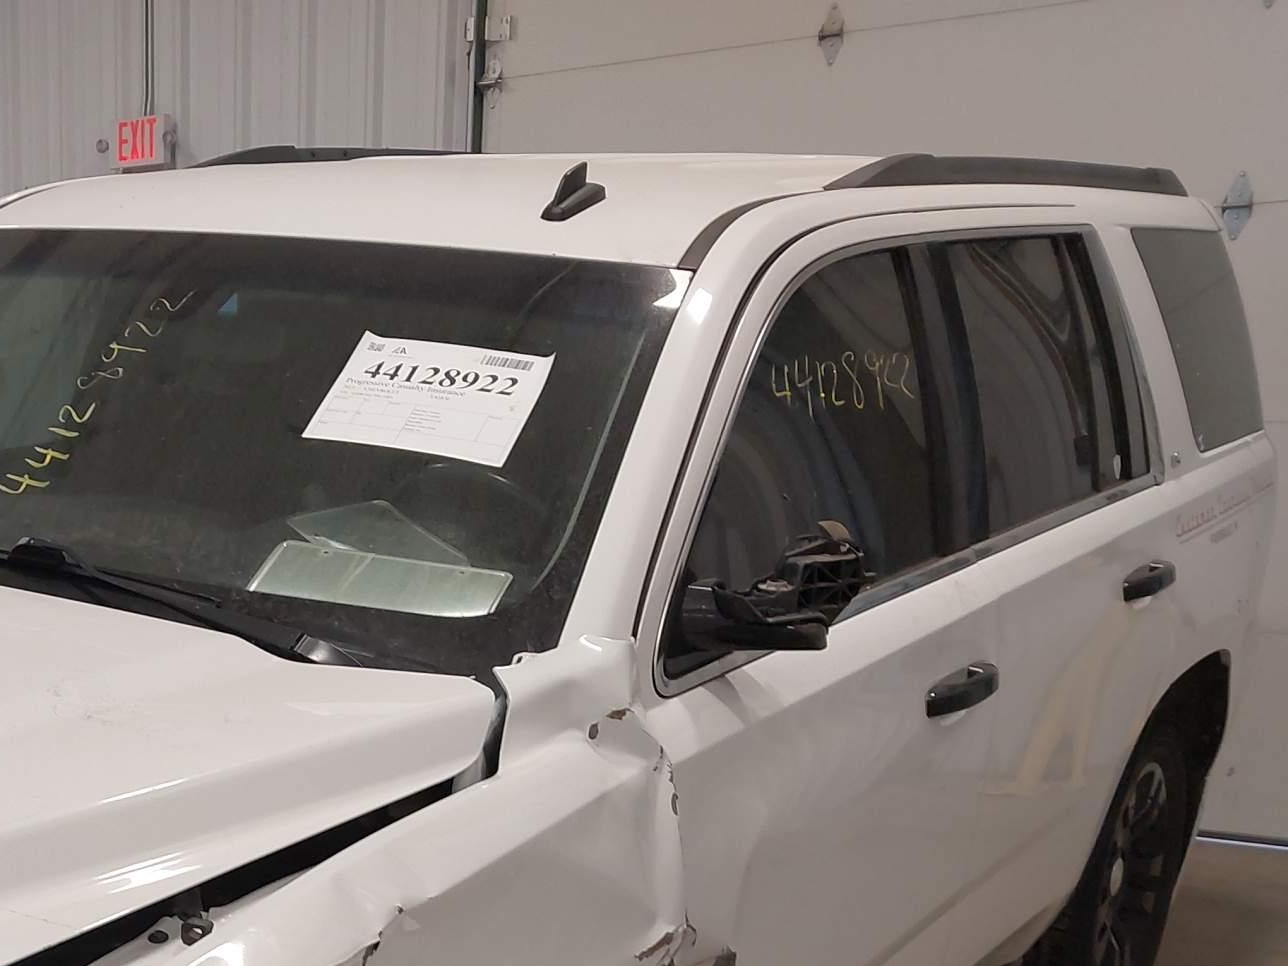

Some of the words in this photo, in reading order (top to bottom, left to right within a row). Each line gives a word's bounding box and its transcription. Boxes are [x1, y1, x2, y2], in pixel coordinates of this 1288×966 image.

[119, 117, 157, 161] EXIT
[346, 377, 390, 388] Progressive
[364, 360, 519, 396] 44128922
